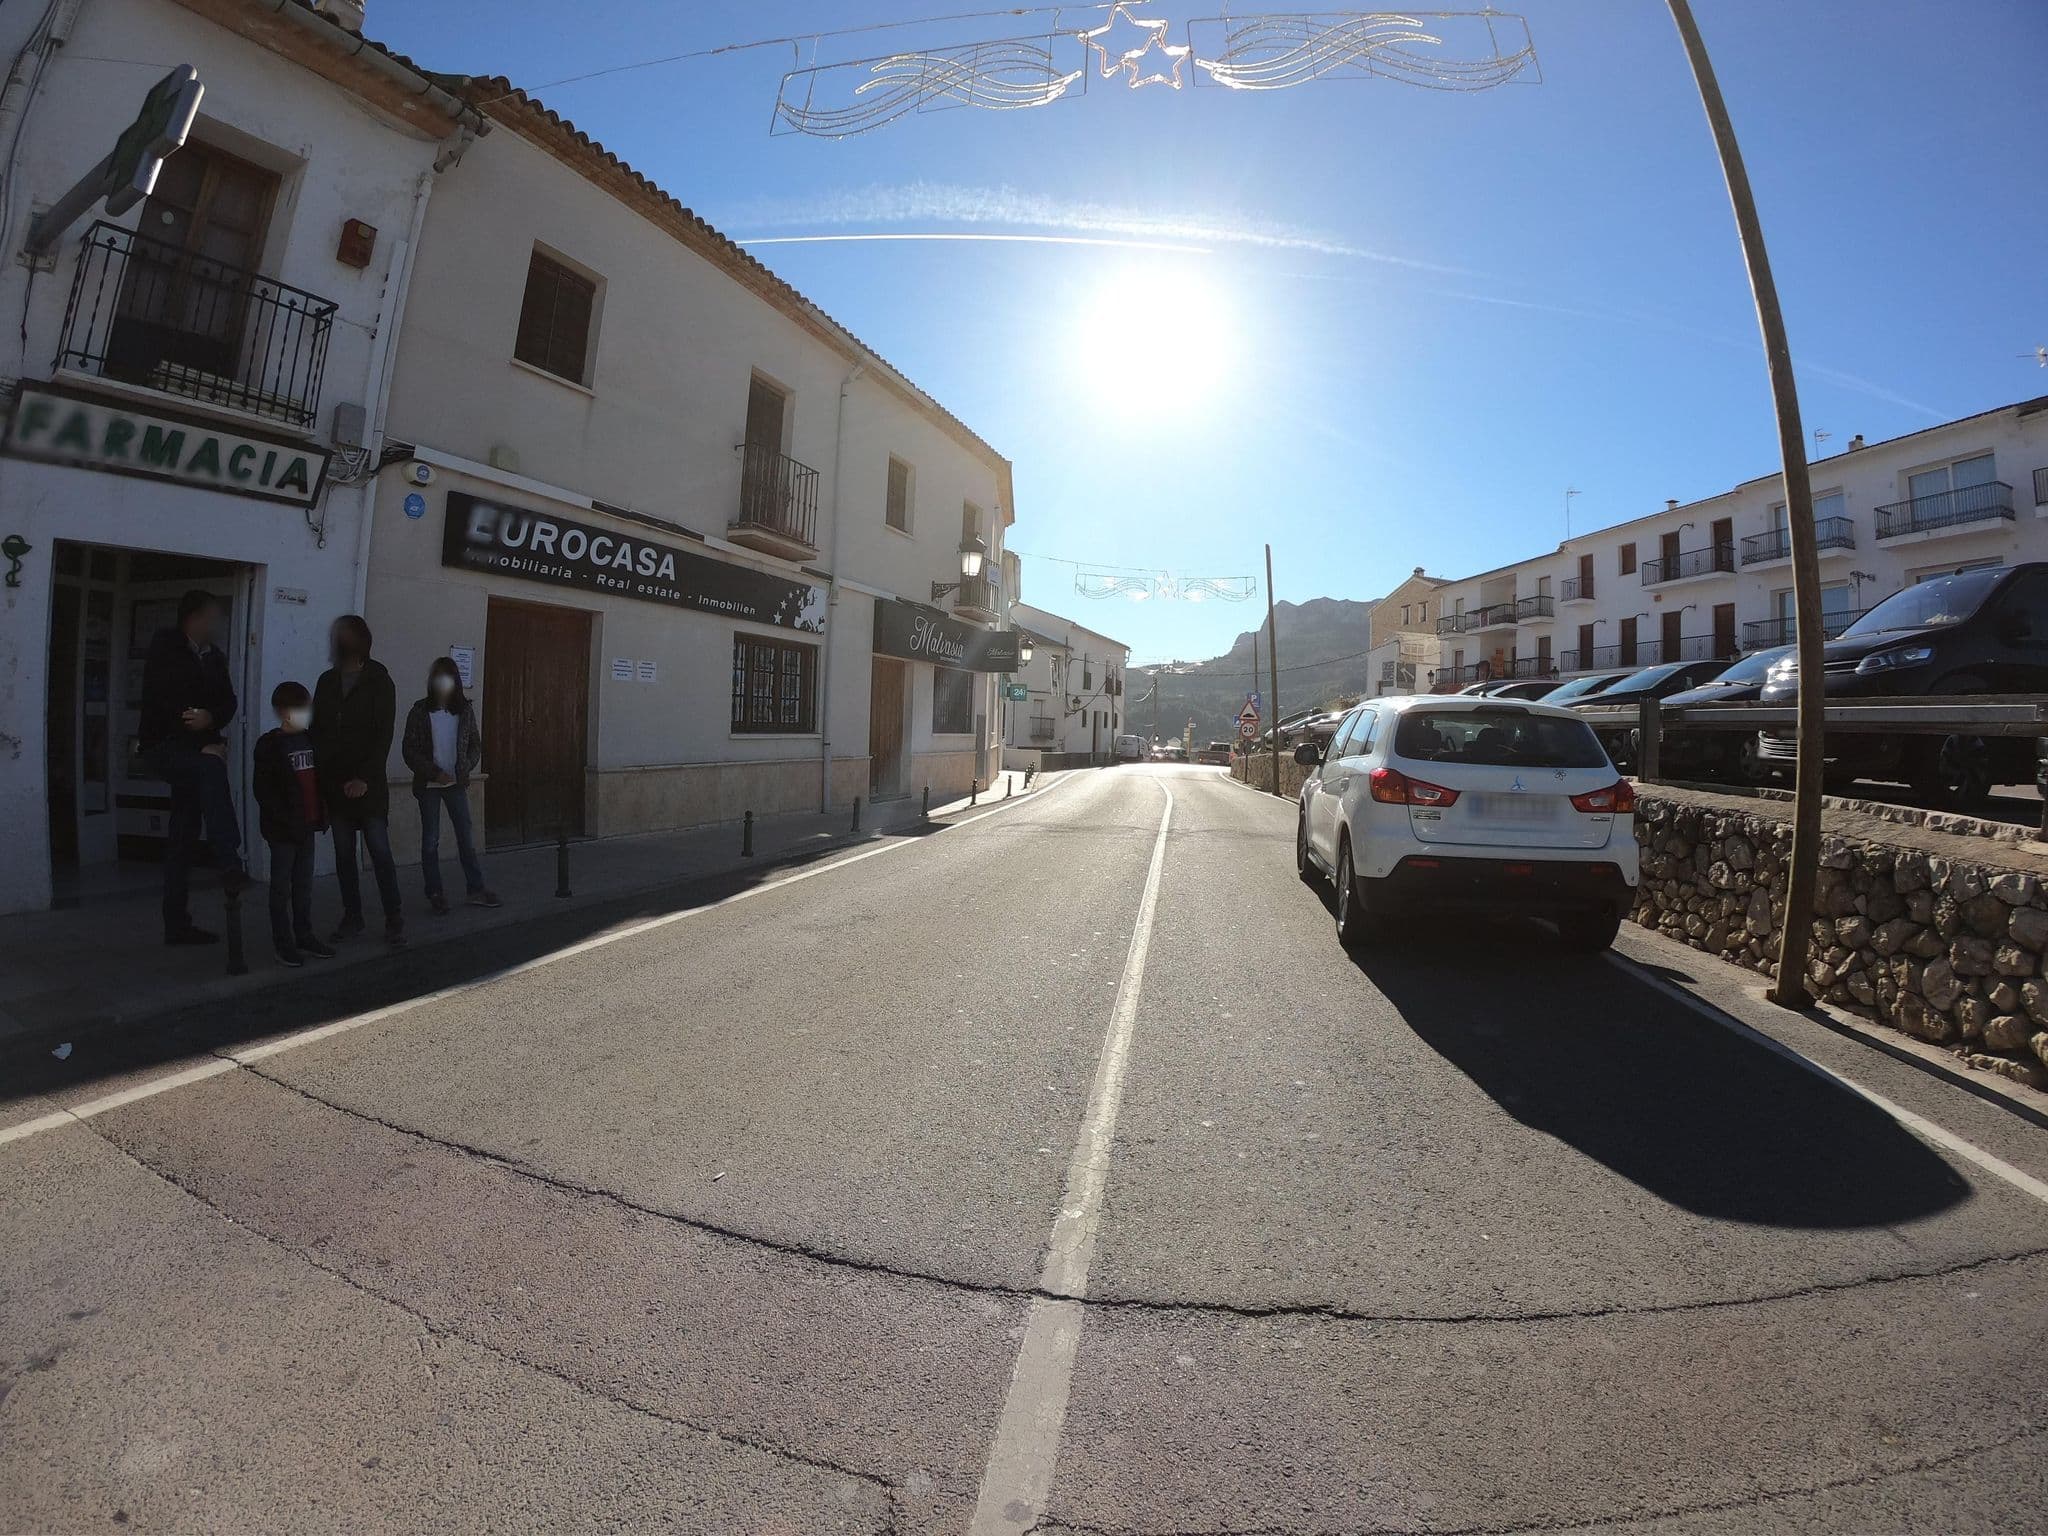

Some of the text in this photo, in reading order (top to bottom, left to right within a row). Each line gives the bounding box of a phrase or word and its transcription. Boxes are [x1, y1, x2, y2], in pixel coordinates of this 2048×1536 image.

[19, 402, 309, 494] FARMACIA
[467, 504, 676, 581] EUROCASA
[465, 547, 572, 579] obiliaria
[596, 573, 631, 590] Real
[637, 583, 681, 600] estate
[698, 594, 756, 615] Inmobilien
[1251, 694, 1257, 702] P
